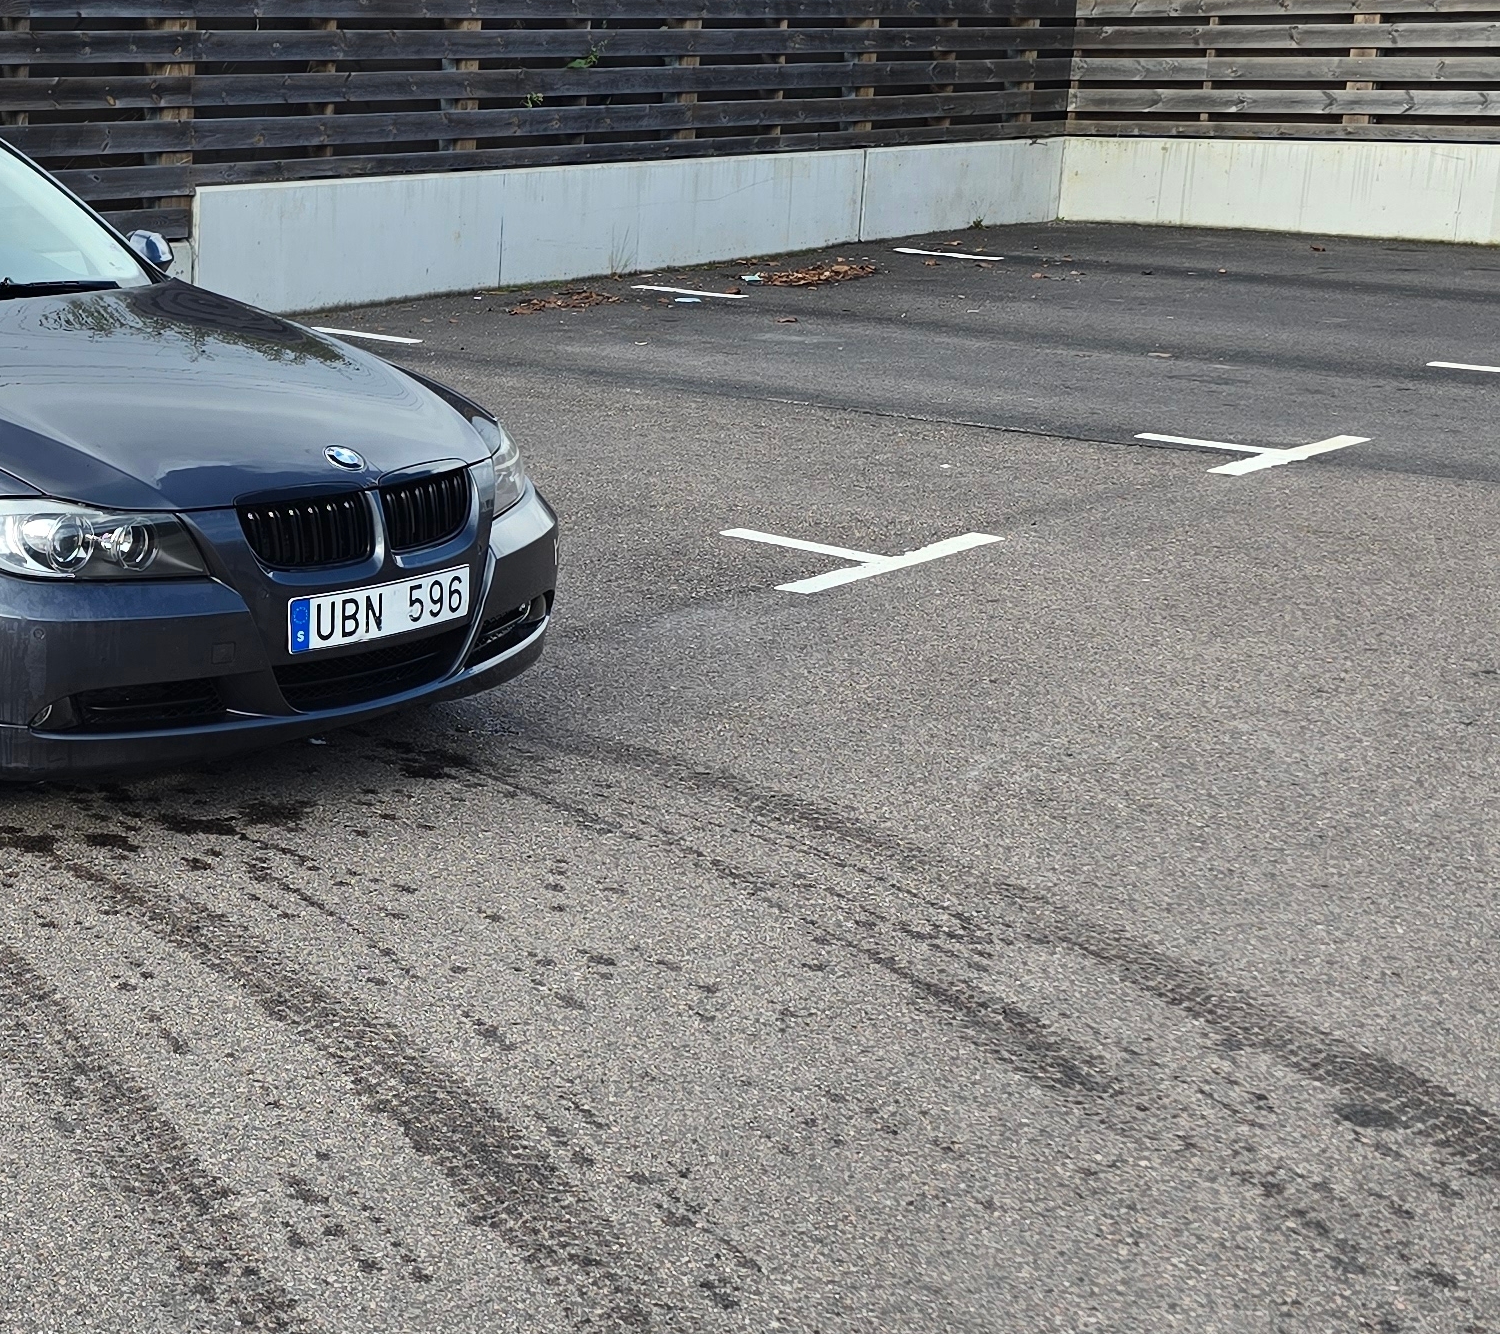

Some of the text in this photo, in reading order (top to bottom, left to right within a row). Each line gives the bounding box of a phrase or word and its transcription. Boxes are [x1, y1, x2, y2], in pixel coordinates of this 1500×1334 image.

[316, 575, 463, 641] UBN 596
[296, 630, 305, 642] S
